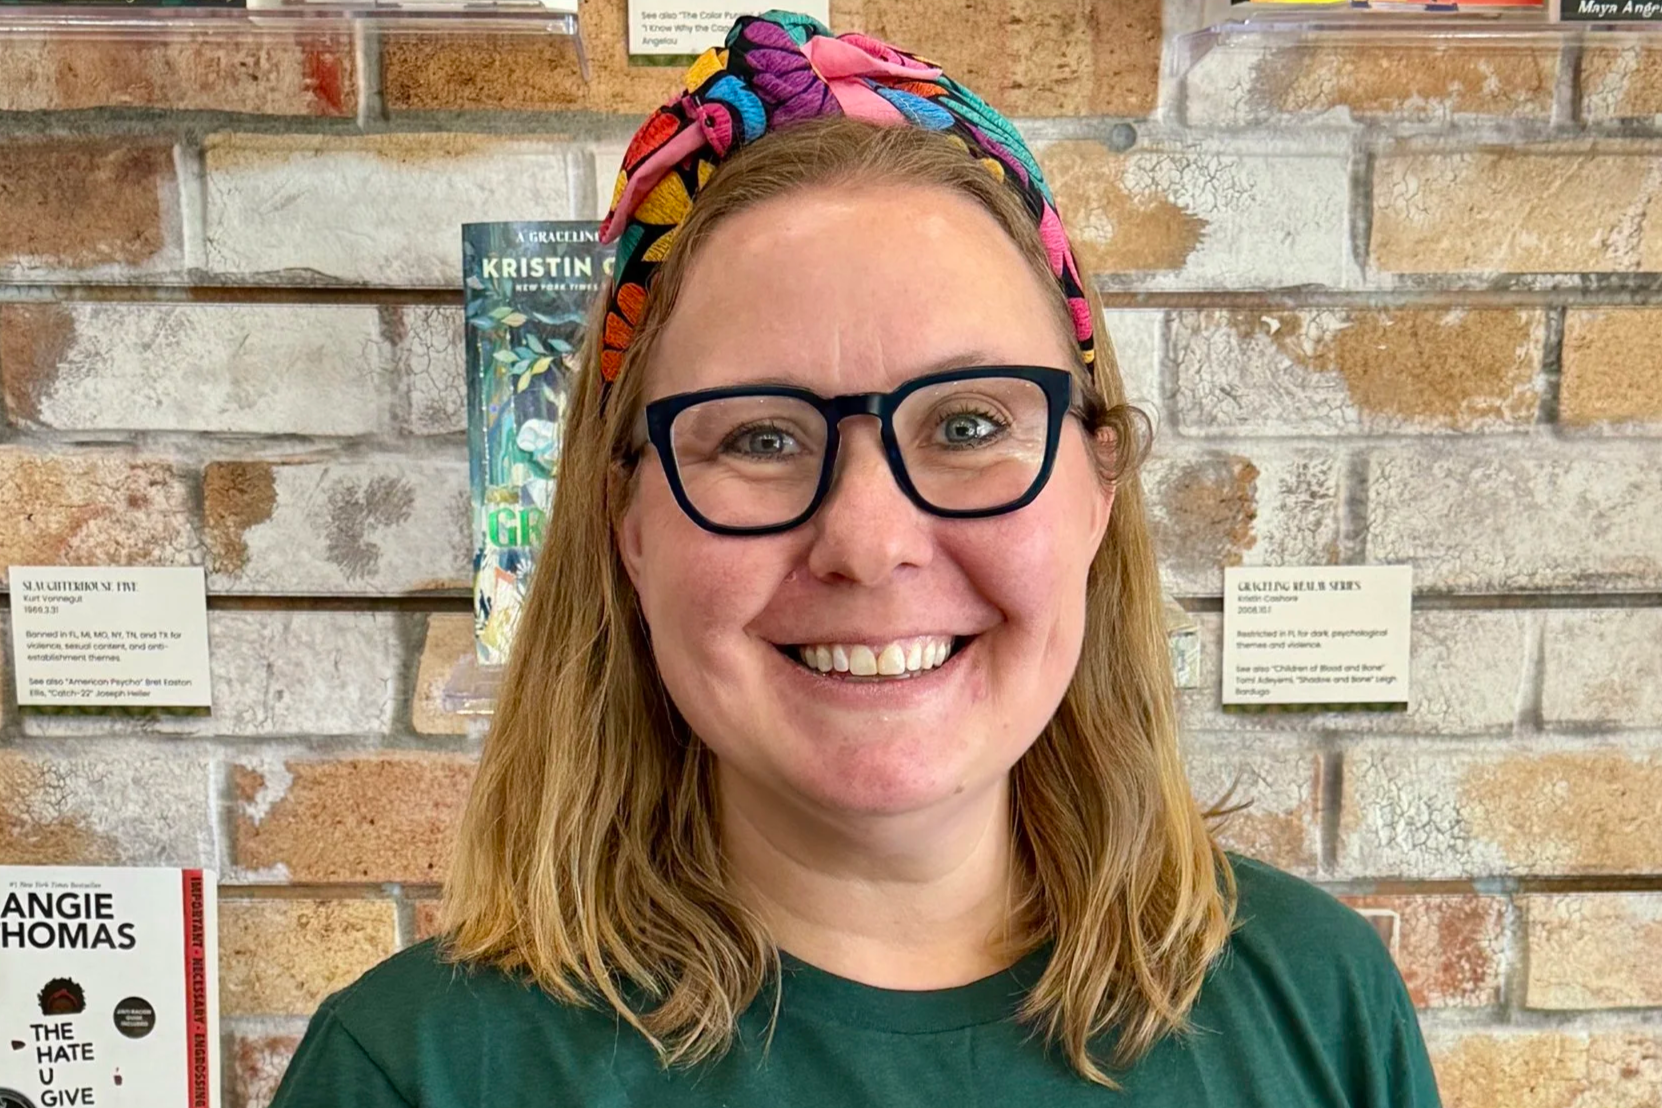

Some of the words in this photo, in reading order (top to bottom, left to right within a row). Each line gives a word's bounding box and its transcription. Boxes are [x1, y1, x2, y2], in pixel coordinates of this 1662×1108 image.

[641, 11, 657, 20] See
[1578, 0, 1618, 18] Maya
[649, 24, 672, 32] Know
[674, 24, 693, 34] Why
[695, 24, 709, 32] the
[642, 37, 678, 48] Angelou
[516, 231, 525, 243] A
[482, 256, 592, 279] KRISTIN
[515, 283, 539, 292] NEW
[541, 283, 566, 291] YORK
[569, 283, 598, 291] TIMES
[42, 595, 83, 604] Vonnegut
[0, 892, 115, 920] ANGIE
[191, 876, 204, 948] IMPORTANT
[0, 921, 137, 950] HOMAS
[192, 957, 207, 1025] NECESSARY
[30, 1022, 75, 1042] THE
[37, 1042, 95, 1064] HATE
[39, 1067, 54, 1086] U
[194, 1033, 207, 1108] ENGROSSING
[41, 1087, 95, 1108] GIVE
